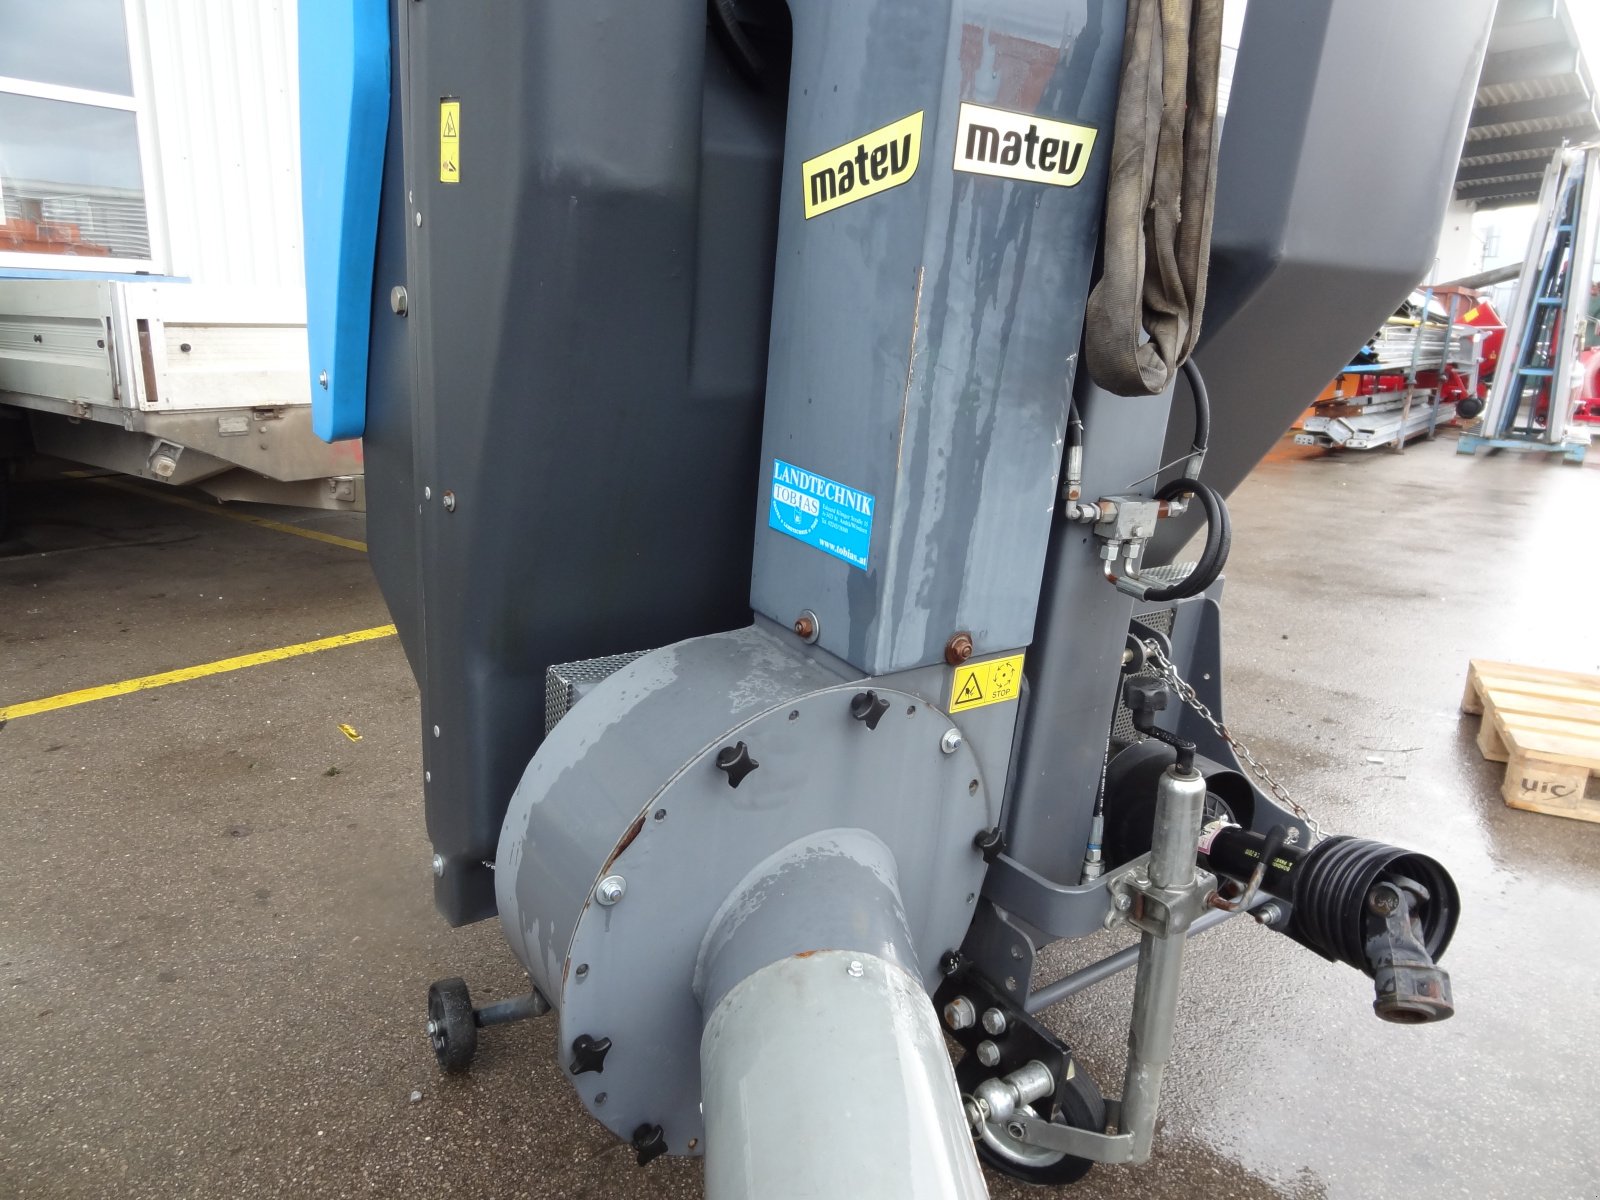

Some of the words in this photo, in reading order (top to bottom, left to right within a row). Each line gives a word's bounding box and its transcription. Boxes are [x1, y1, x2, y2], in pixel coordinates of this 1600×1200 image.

[810, 133, 912, 206] matev
[965, 123, 1083, 175] matev
[774, 462, 872, 516] LANDTECHNIK
[776, 484, 818, 514] TOBIAS
[819, 538, 867, 566] www.tobias.at
[992, 688, 1011, 699] STOP
